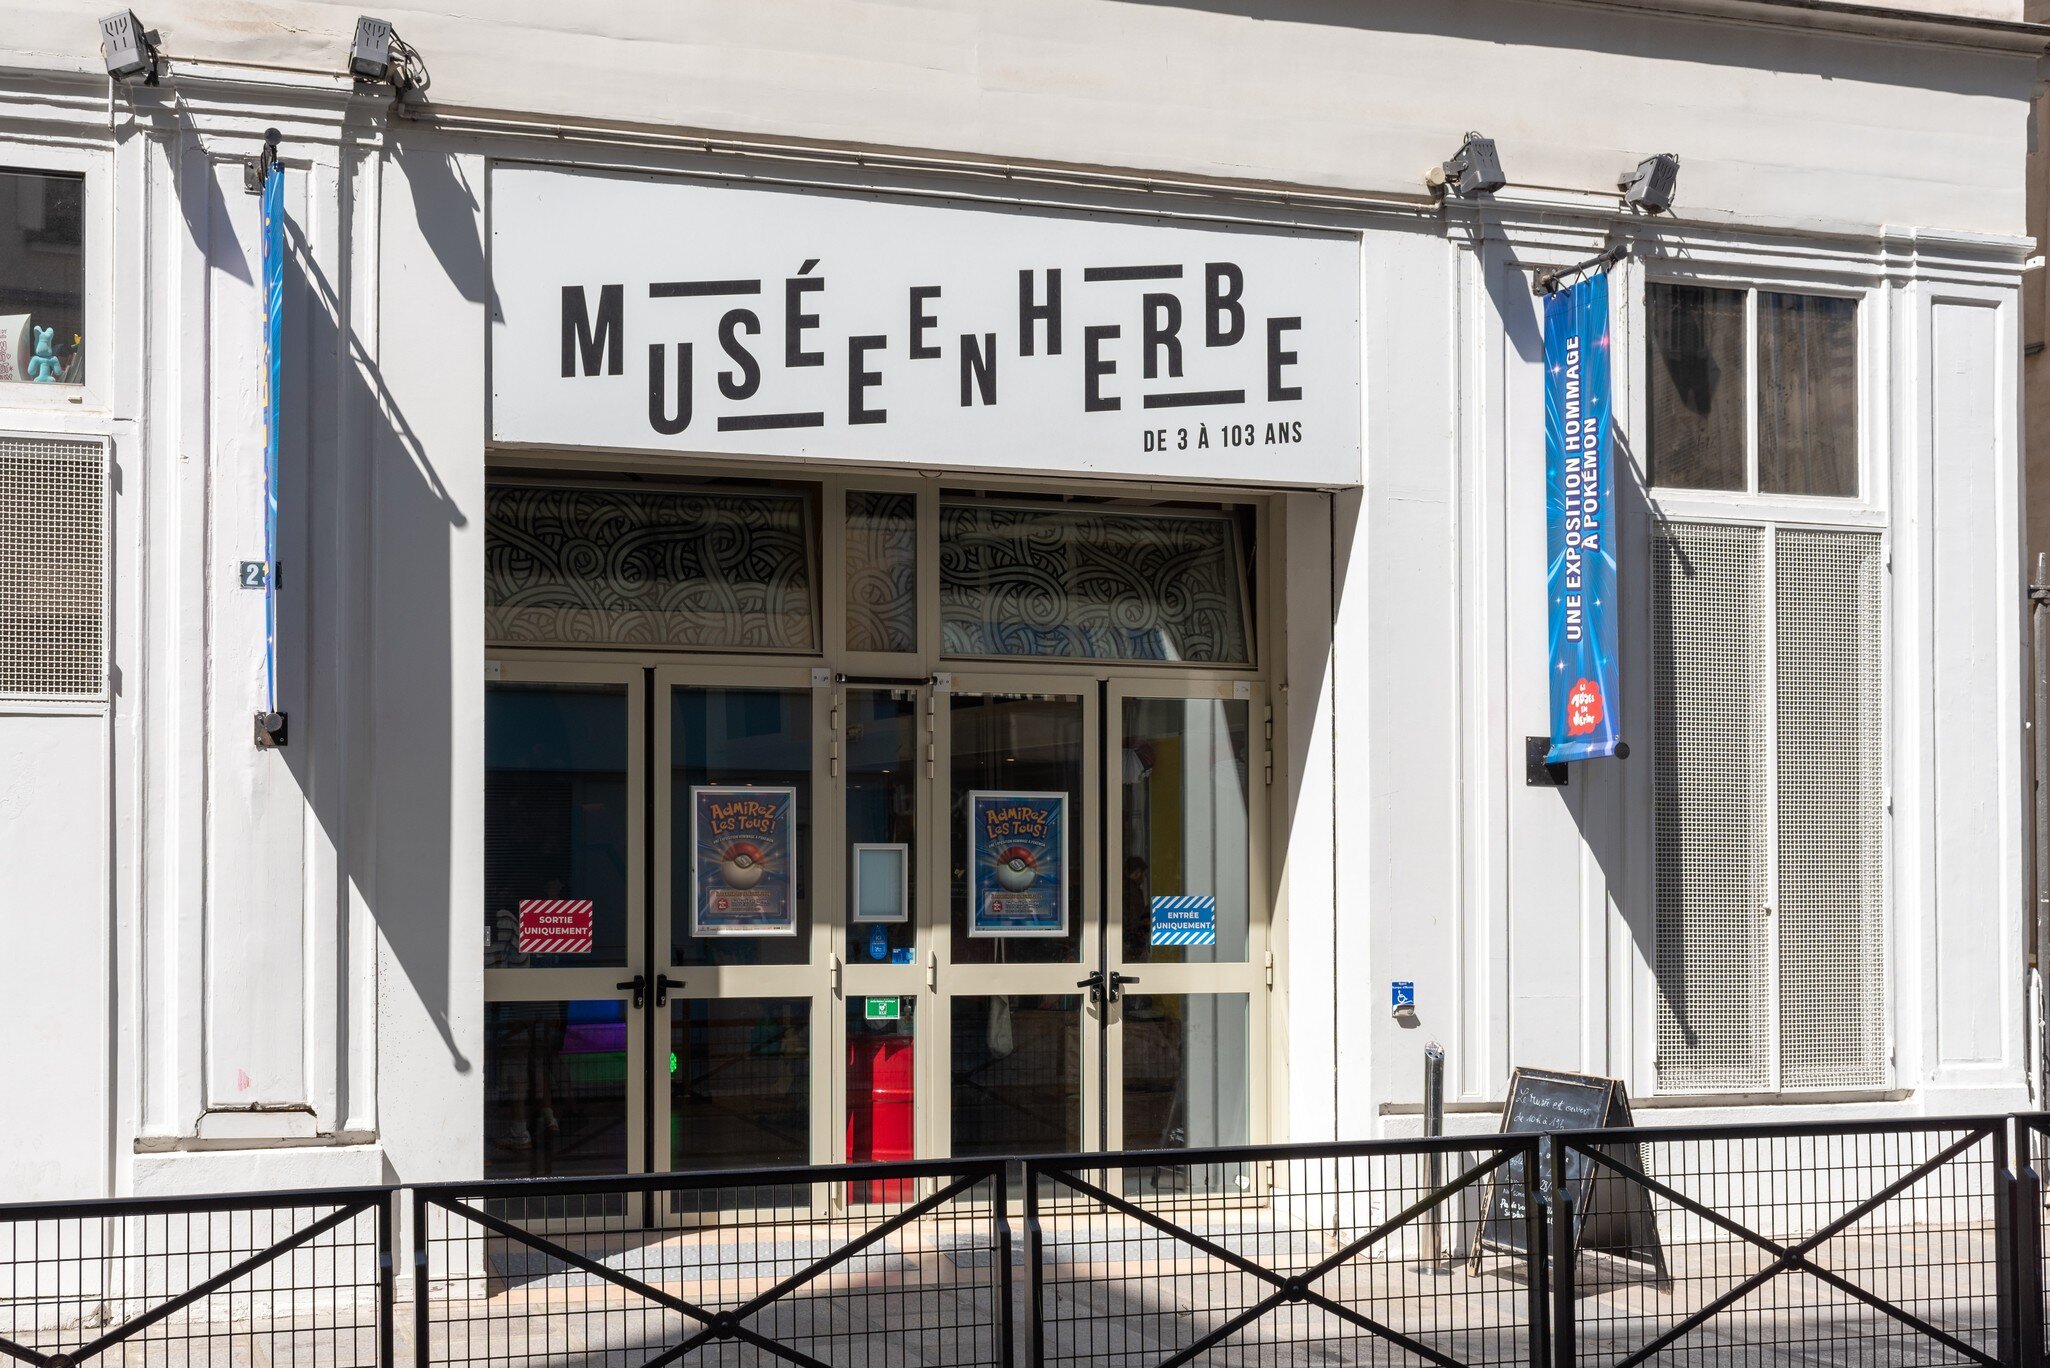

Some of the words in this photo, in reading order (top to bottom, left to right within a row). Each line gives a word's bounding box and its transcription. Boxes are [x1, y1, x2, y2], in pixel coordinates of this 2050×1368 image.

[1565, 335, 1580, 450] HOMMAGE
[1143, 429, 1167, 452] DE
[1177, 428, 1188, 450] 3
[1198, 422, 1209, 449] À
[1221, 424, 1255, 447] 103
[1265, 421, 1302, 445] ANS
[1580, 417, 1598, 527] POKÉMON
[1565, 457, 1581, 588] EXPOSITION
[1582, 534, 1598, 549] À
[1566, 594, 1582, 641] UNE
[539, 916, 573, 924] SORTIE
[1156, 922, 1211, 930] UNIQUEMENT
[1167, 910, 1199, 919] ENTRÉE
[524, 927, 588, 935] UNIQUEMENT
